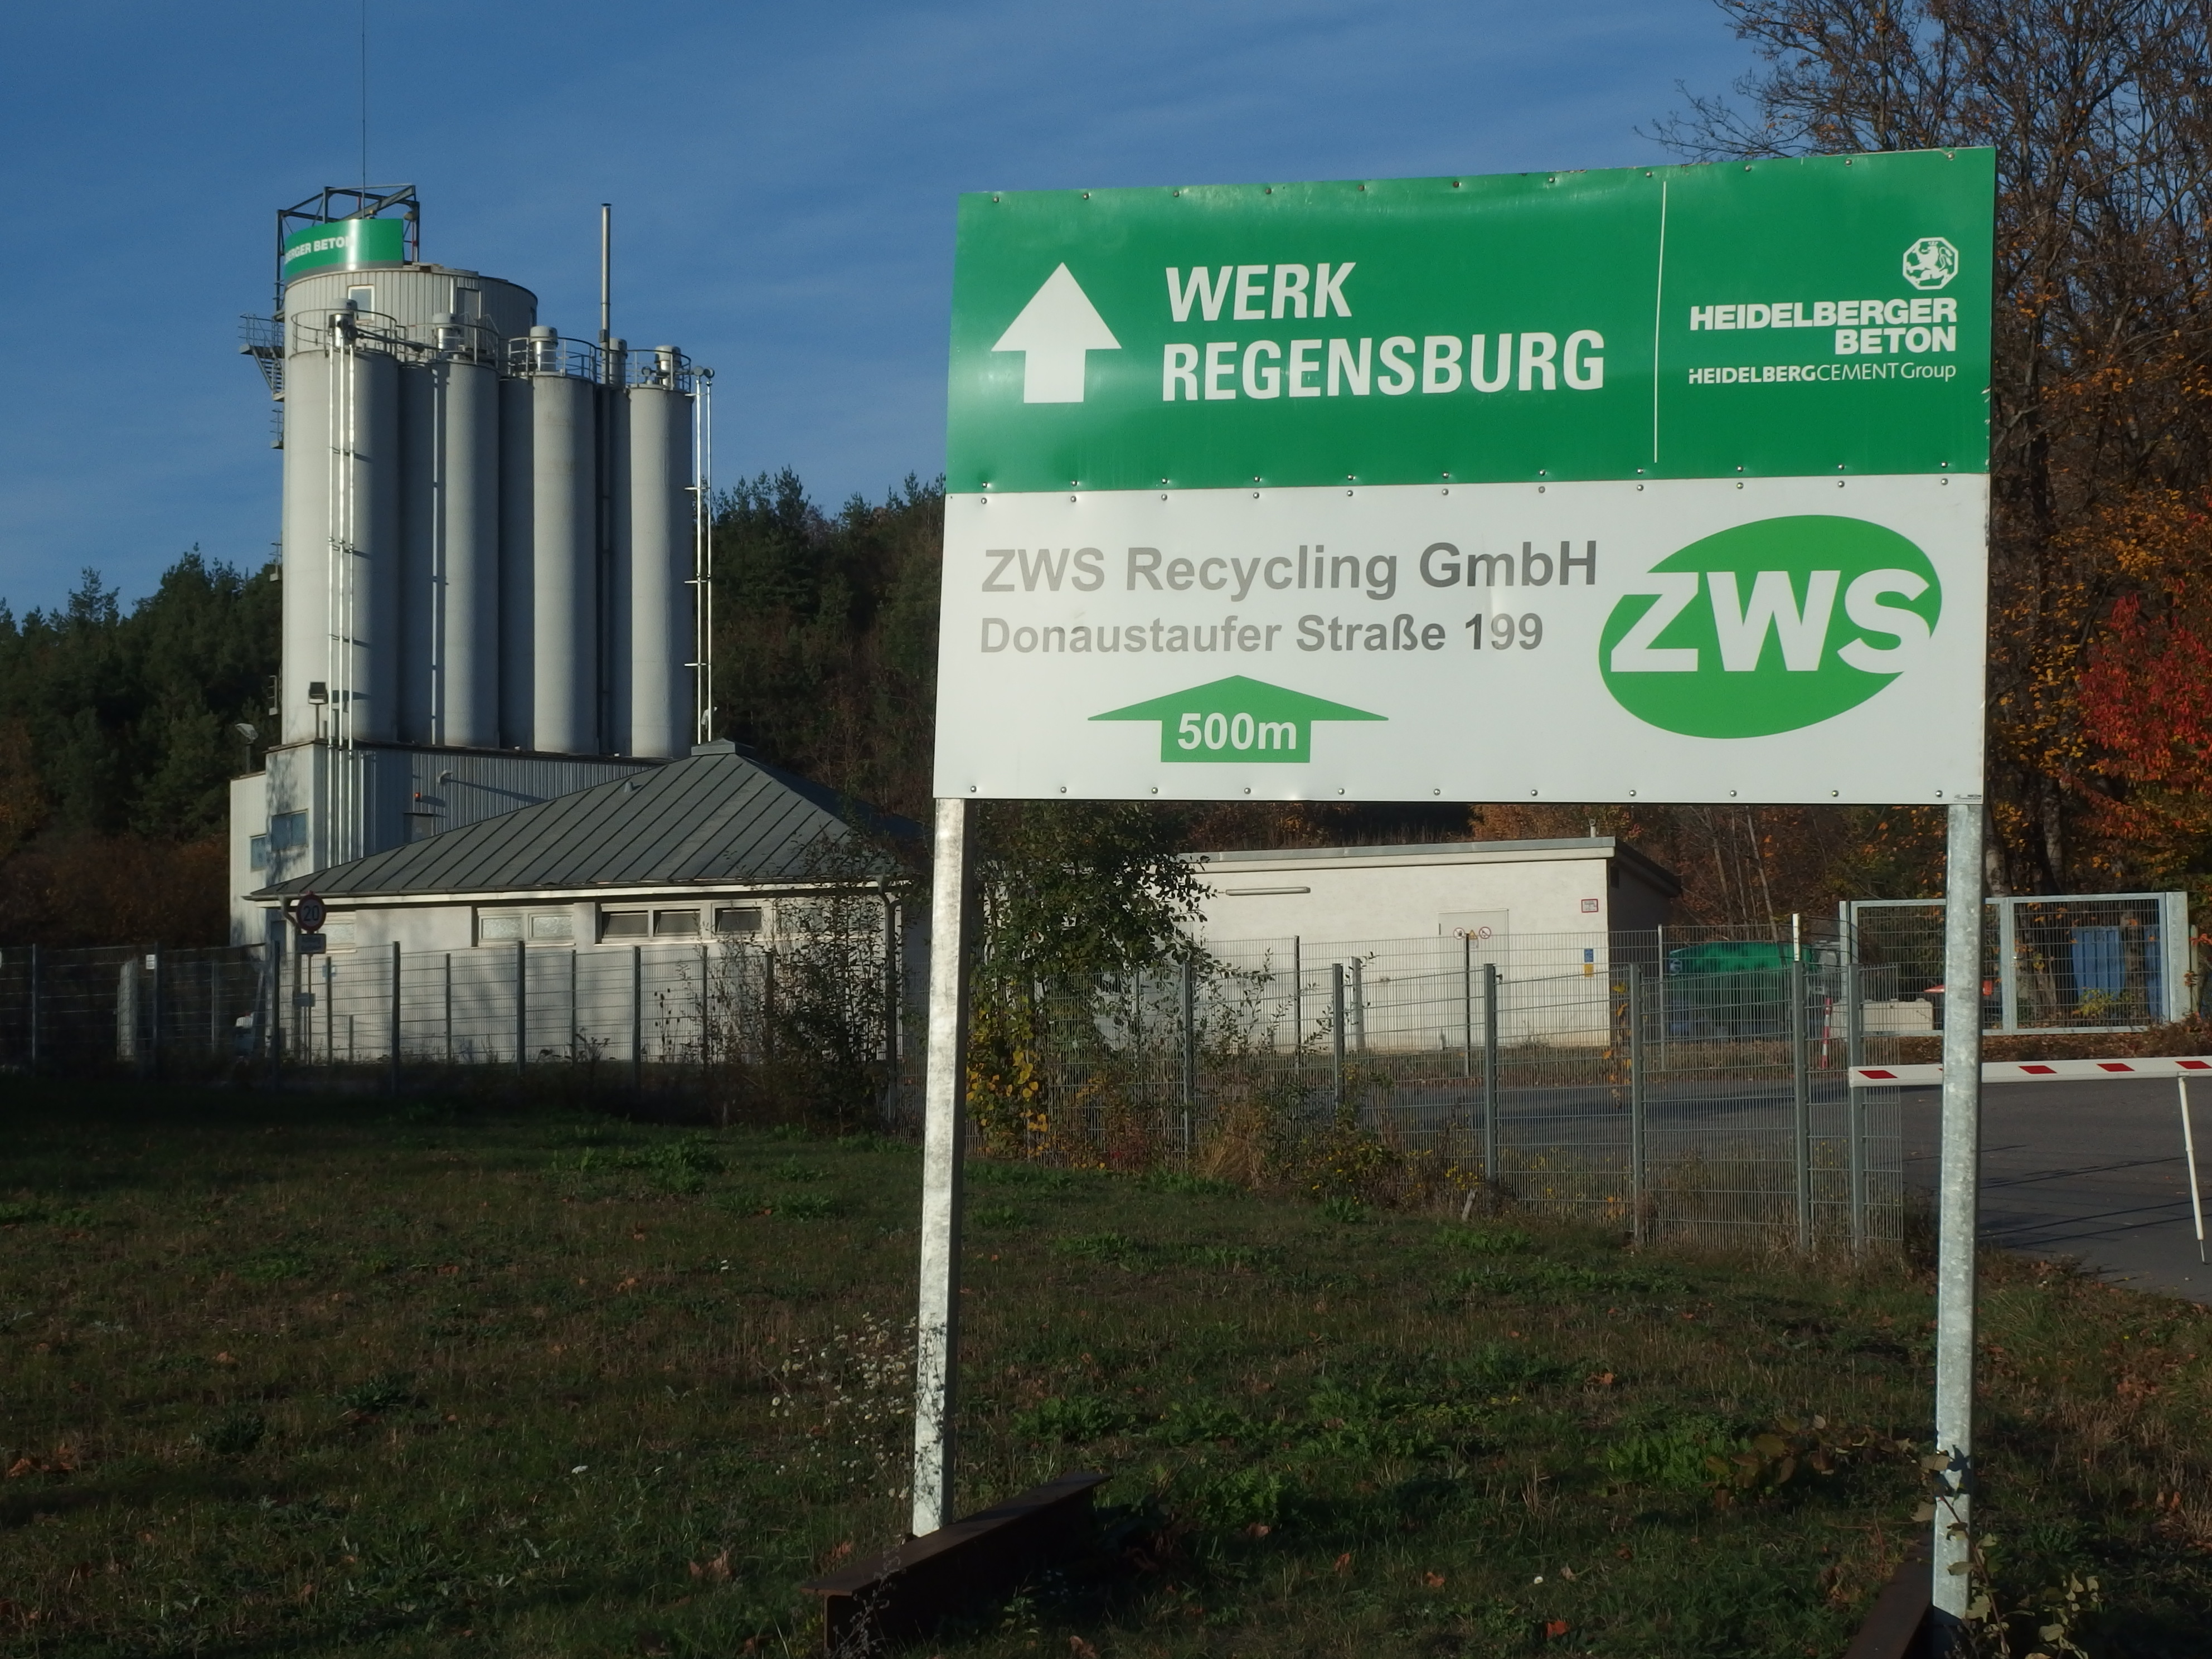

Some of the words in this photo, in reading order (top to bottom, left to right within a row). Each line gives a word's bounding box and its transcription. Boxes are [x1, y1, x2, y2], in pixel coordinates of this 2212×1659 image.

[1166, 263, 1356, 322] WERK
[1690, 298, 1957, 331] HEIDELBERGER
[1835, 327, 1956, 355] BETON
[1163, 330, 1604, 401] REGENSBURG
[1689, 363, 1899, 384] HEIDELBERGCEMENT
[1901, 361, 1956, 382] Group
[982, 547, 1105, 592] ZWS
[1127, 544, 1397, 601] Recycling
[1420, 540, 1597, 588] GmbH
[981, 615, 1282, 653] Donaustaufer
[1297, 614, 1446, 652] Straße
[1465, 613, 1543, 651] 199
[1611, 568, 1931, 675] ZWS
[1177, 712, 1297, 750] 500m
[303, 905, 320, 921] 20
